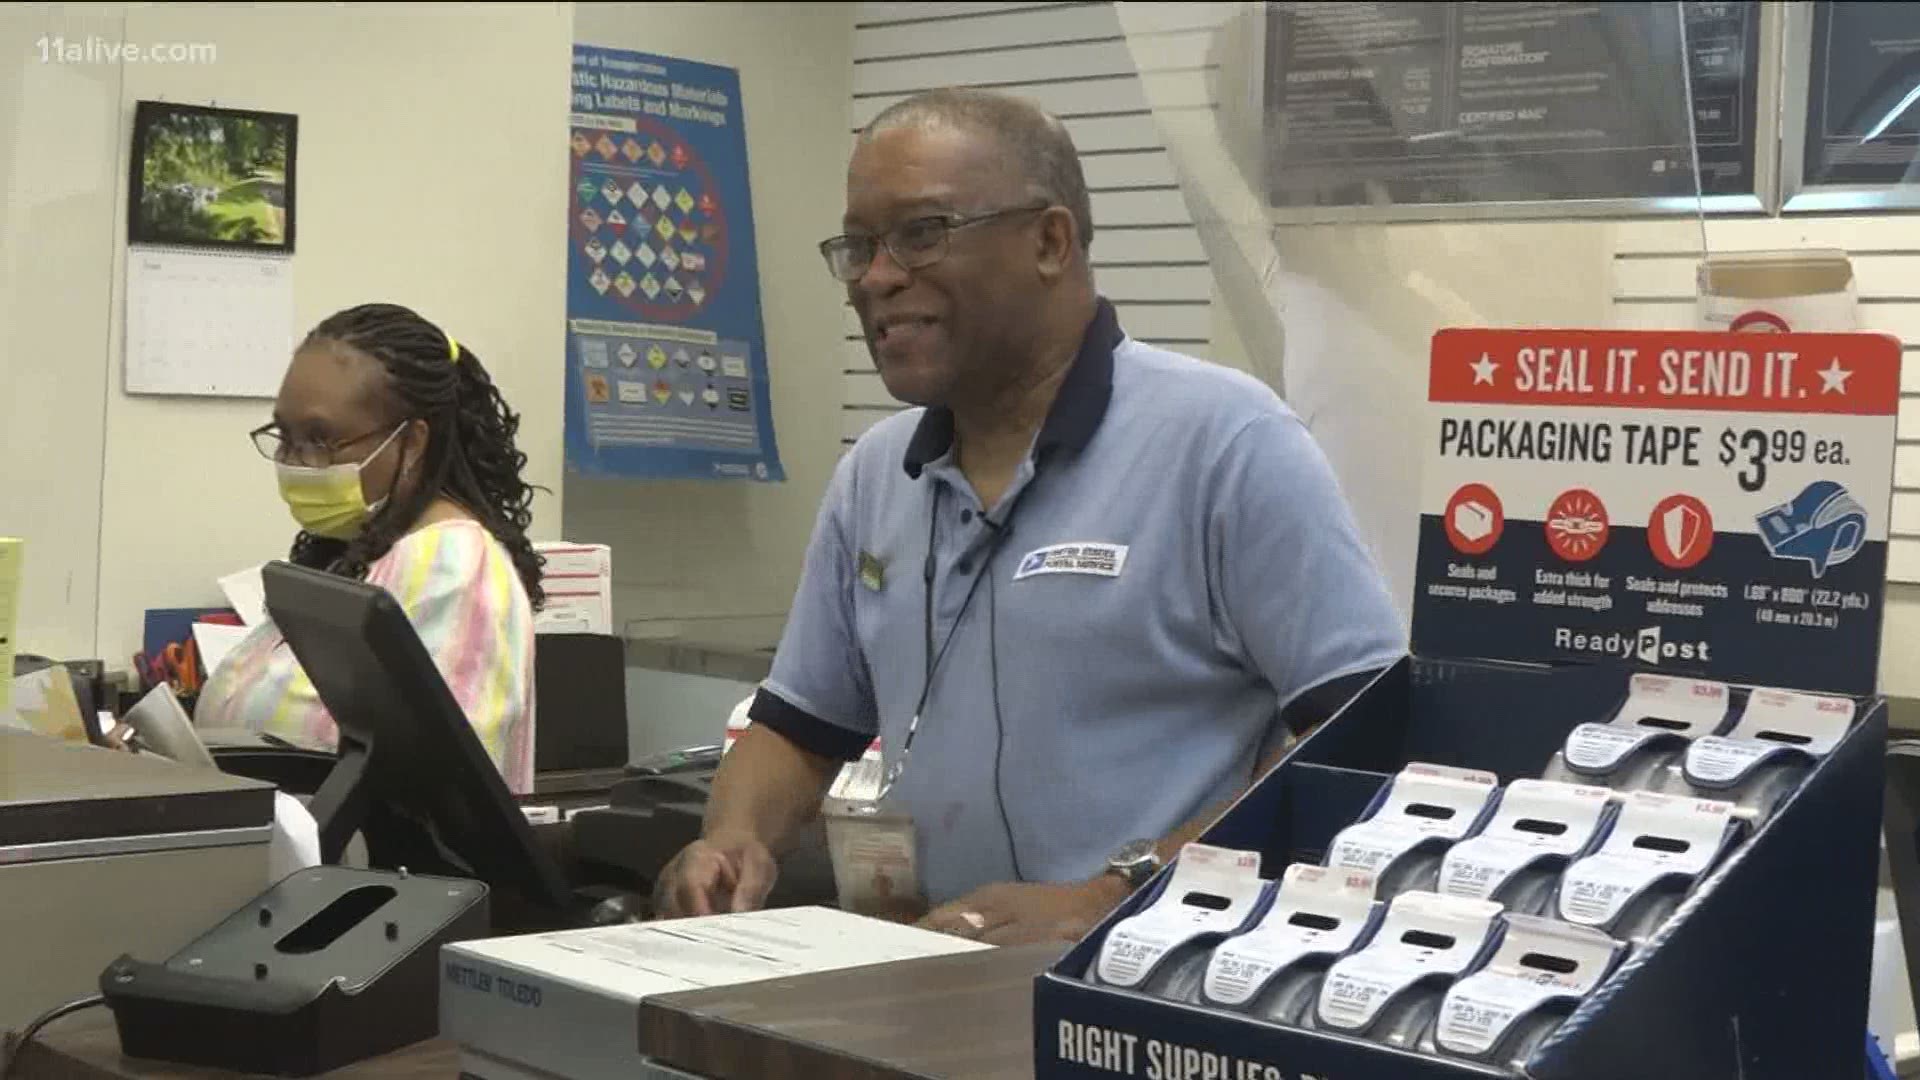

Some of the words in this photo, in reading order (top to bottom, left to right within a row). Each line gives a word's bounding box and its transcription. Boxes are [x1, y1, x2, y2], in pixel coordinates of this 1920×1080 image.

[1514, 347, 1593, 393] SEAL
[1604, 348, 1646, 395] IT.
[1657, 349, 1751, 397] SEND
[1761, 351, 1807, 399] IT.
[1439, 418, 1613, 463] PACKAGING
[1621, 425, 1701, 466] TAPE
[1813, 437, 1851, 466] ea.
[1535, 568, 1563, 585] Extra
[1565, 571, 1592, 588] thick
[1555, 626, 1709, 665] ReadyPost
[496, 975, 542, 1009] TOLEDO
[1057, 1019, 1138, 1075] RIGHT
